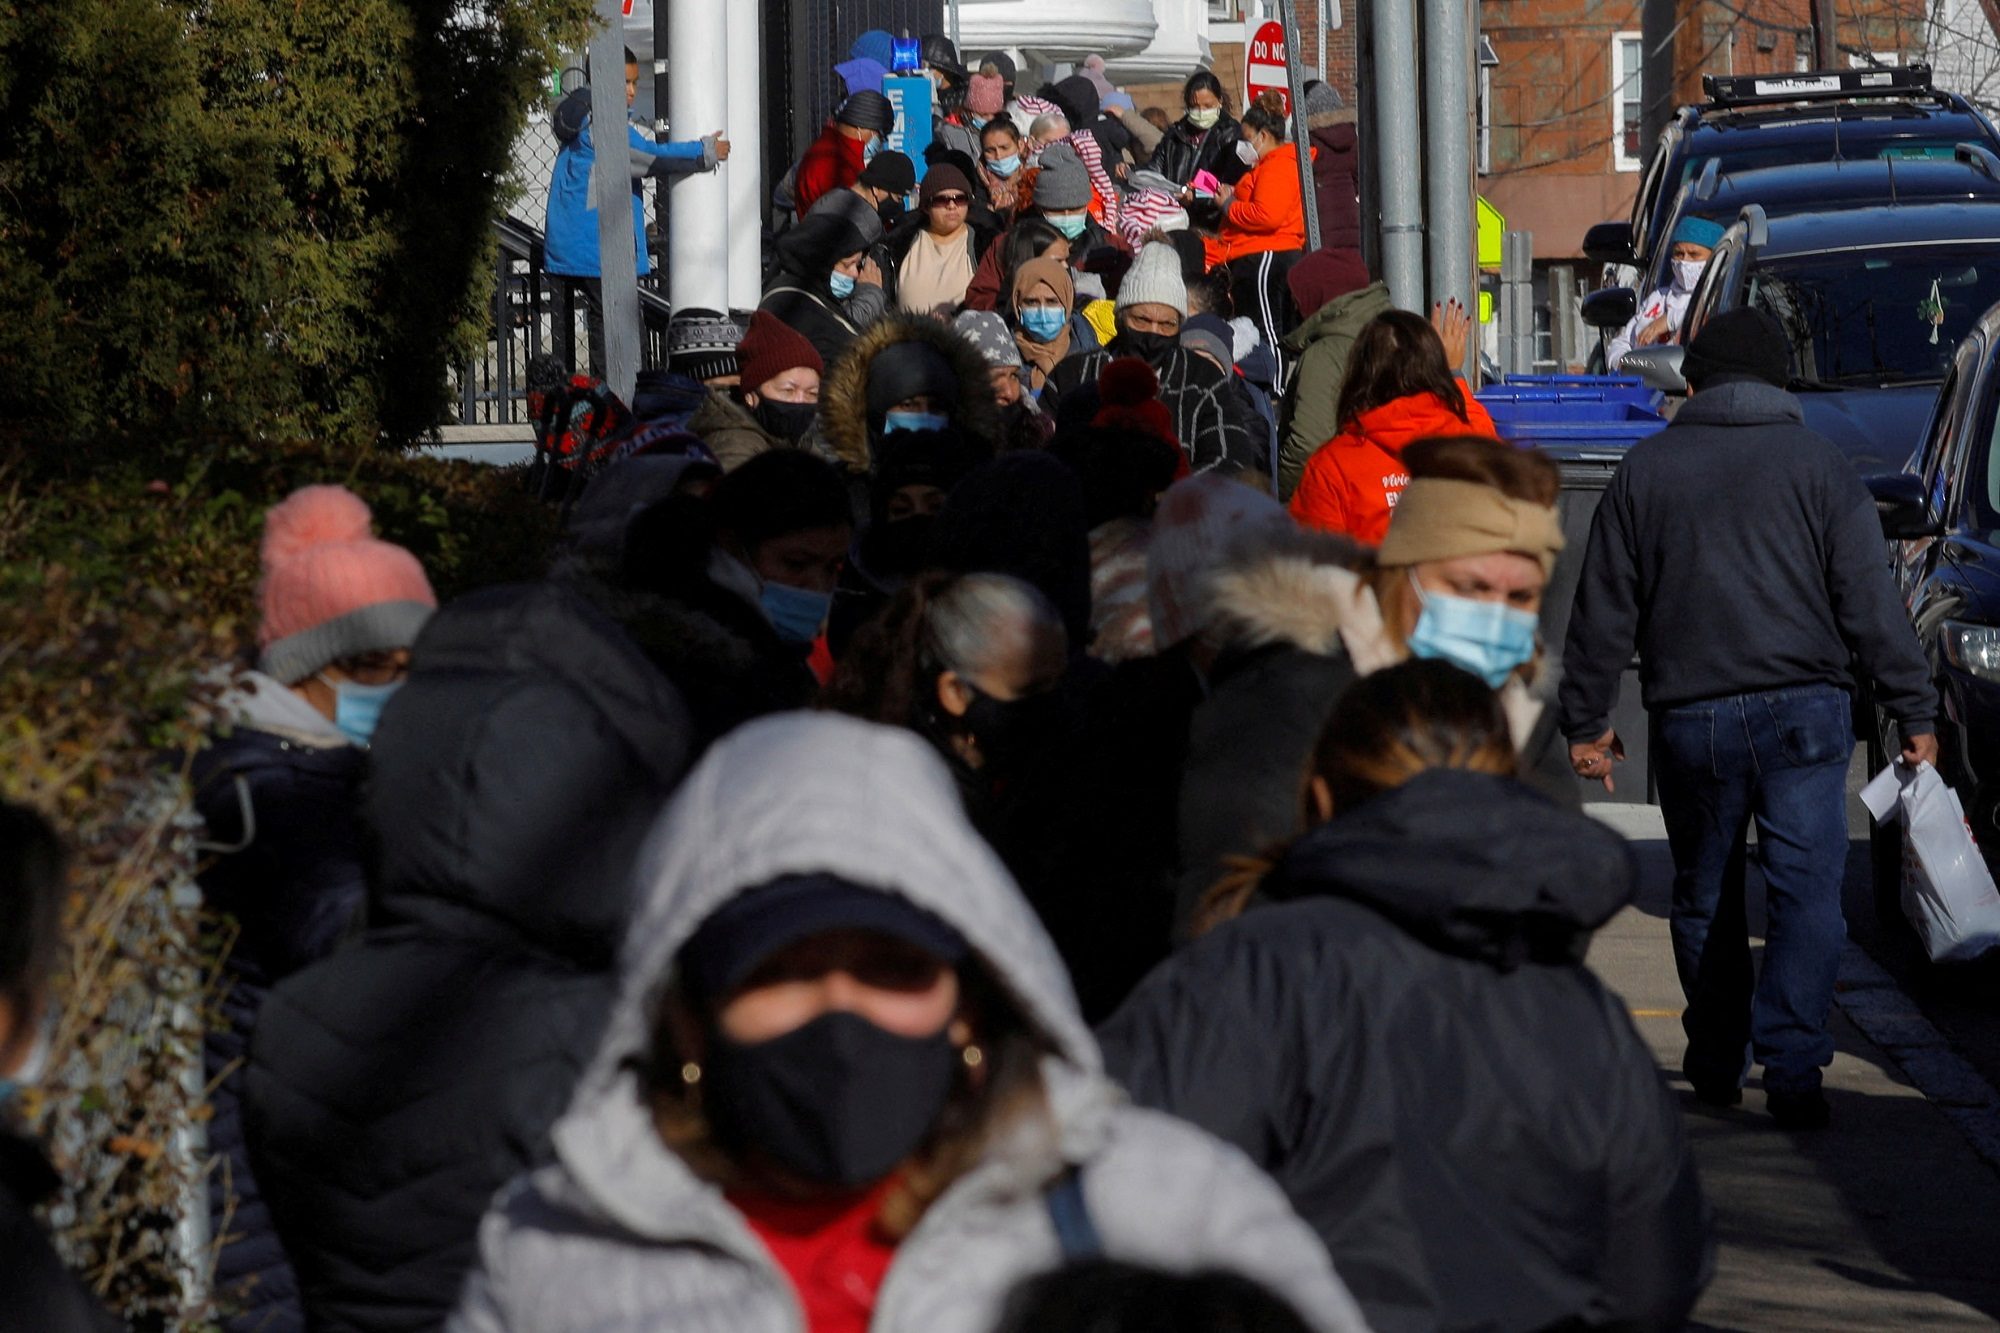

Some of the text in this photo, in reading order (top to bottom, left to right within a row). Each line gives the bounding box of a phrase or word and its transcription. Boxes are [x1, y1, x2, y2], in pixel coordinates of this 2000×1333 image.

[1254, 40, 1286, 61] DO NO
[887, 88, 905, 153] EME
